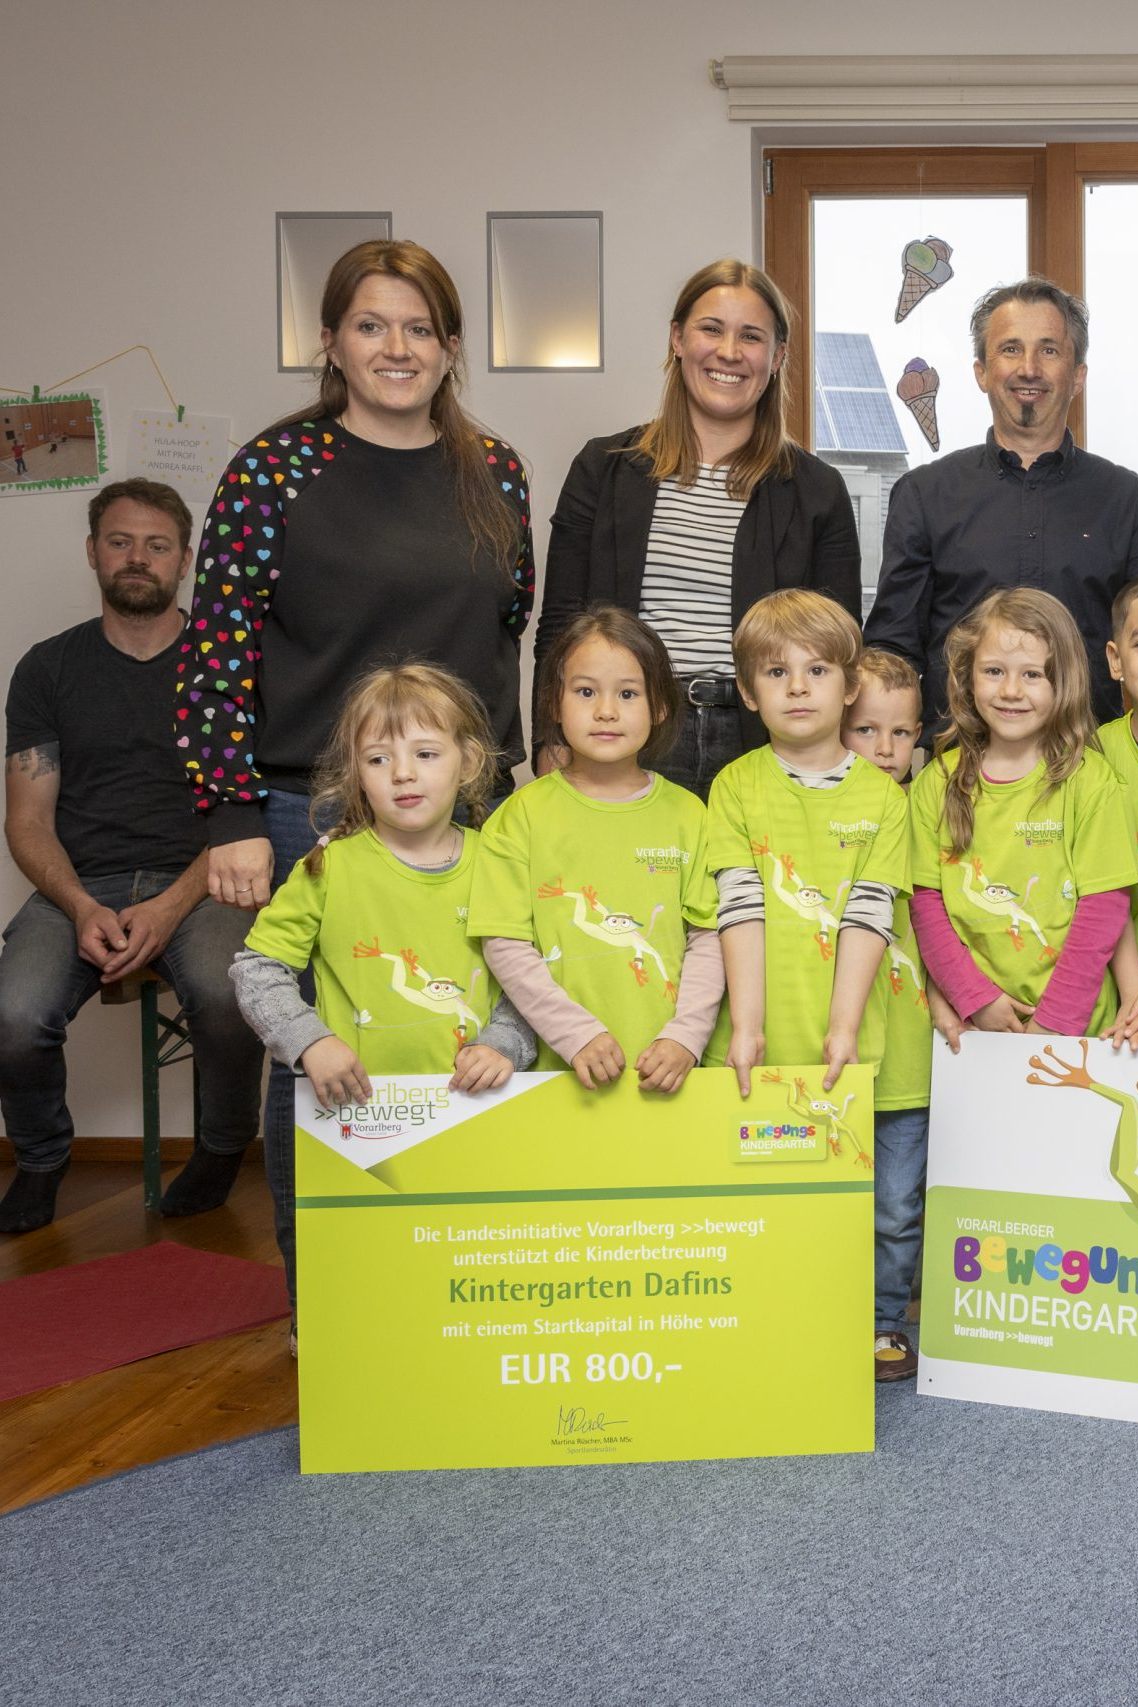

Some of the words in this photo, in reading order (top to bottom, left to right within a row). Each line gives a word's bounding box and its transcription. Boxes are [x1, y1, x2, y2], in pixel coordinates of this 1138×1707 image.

[353, 1122, 402, 1133] Vorarlberg
[740, 1139, 816, 1150] KINDERGARTEN
[413, 1226, 441, 1244] Die
[447, 1221, 582, 1242] Landesinitiative
[586, 1219, 675, 1240] Vorarlberg
[956, 1217, 1055, 1238] VORARLBERGER
[453, 1248, 548, 1267] unterstützt
[554, 1246, 580, 1263] die
[586, 1243, 727, 1263] Kinderbetreuung
[449, 1275, 632, 1308] Kintergarten
[644, 1270, 733, 1298] Dafins
[442, 1320, 471, 1338] mit
[477, 1319, 528, 1337] einem
[533, 1316, 632, 1337] Startkapital
[638, 1315, 654, 1332] in
[660, 1314, 704, 1331] Höhe
[708, 1315, 738, 1330] von
[953, 1323, 1004, 1342] Vorarlberg
[501, 1352, 571, 1385] EUR
[585, 1351, 683, 1385] 800,-
